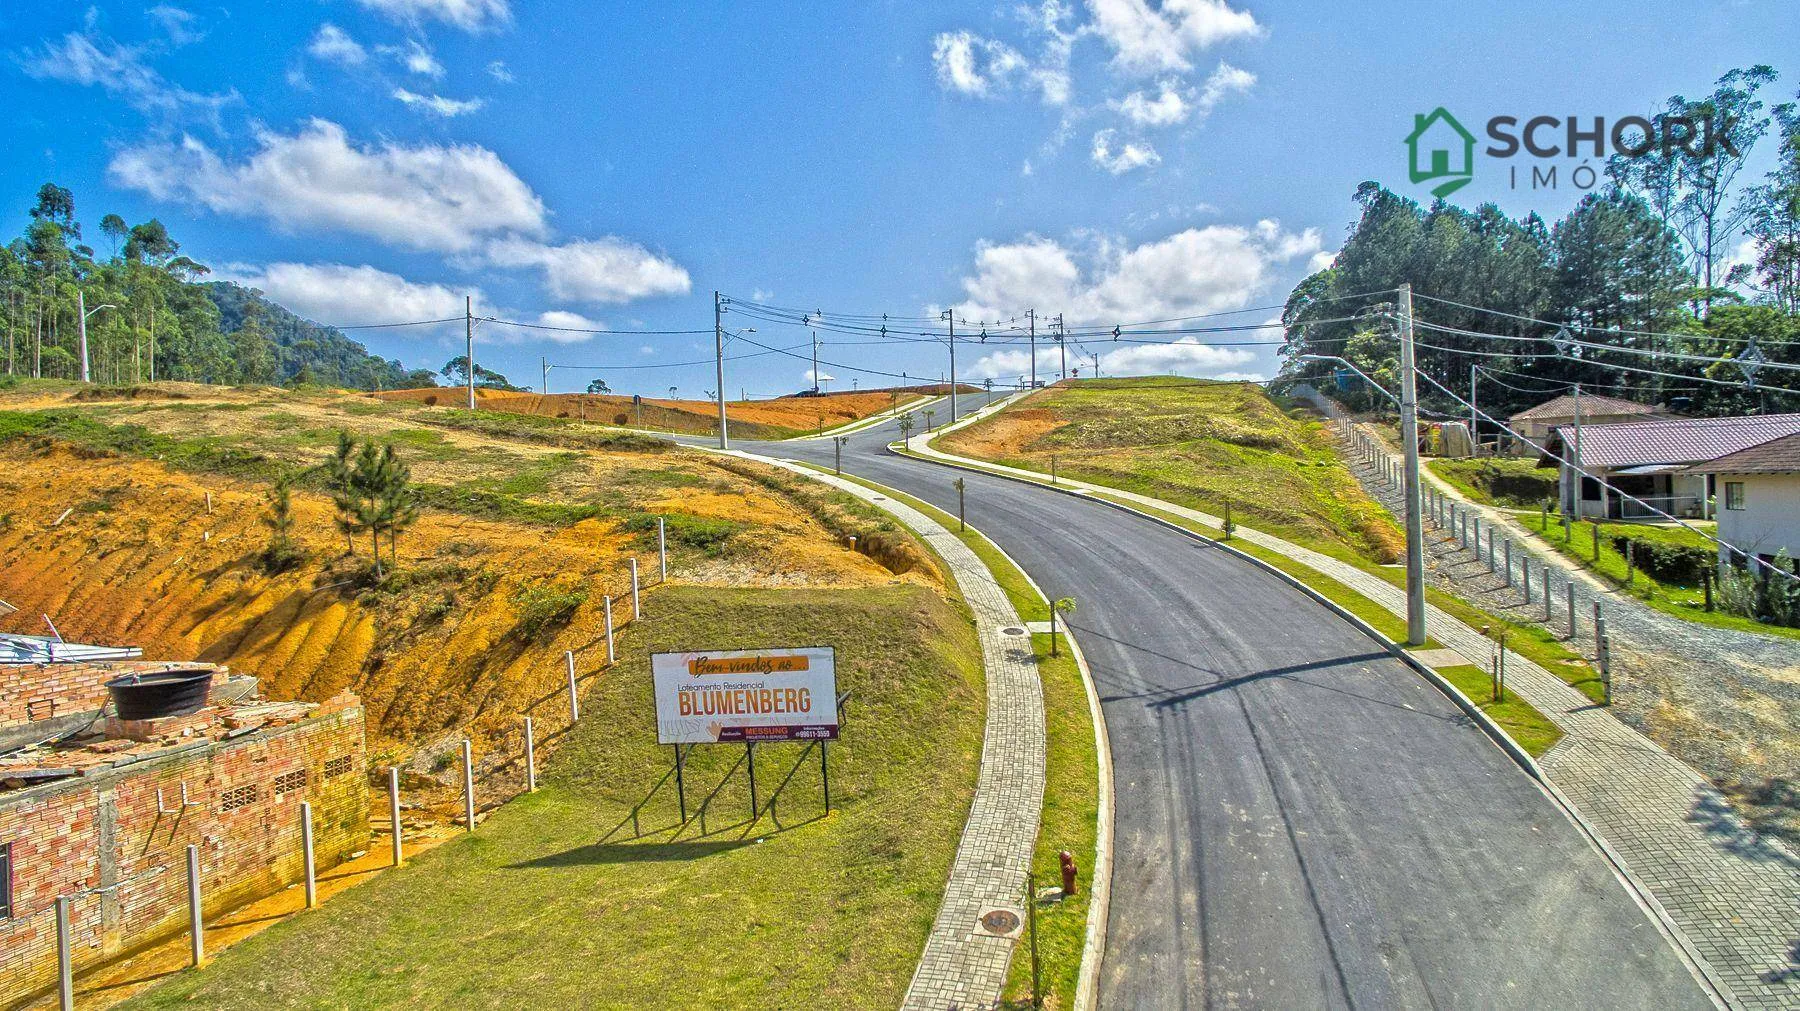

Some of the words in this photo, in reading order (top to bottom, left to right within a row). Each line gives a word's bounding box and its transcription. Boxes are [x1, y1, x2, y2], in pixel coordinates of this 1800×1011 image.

[694, 655, 773, 678] Bem-vindos
[677, 683, 722, 692] Loteamento
[723, 681, 765, 690] Residencial
[678, 687, 811, 716] BLUMENBERG
[745, 727, 788, 735] MESSUNG
